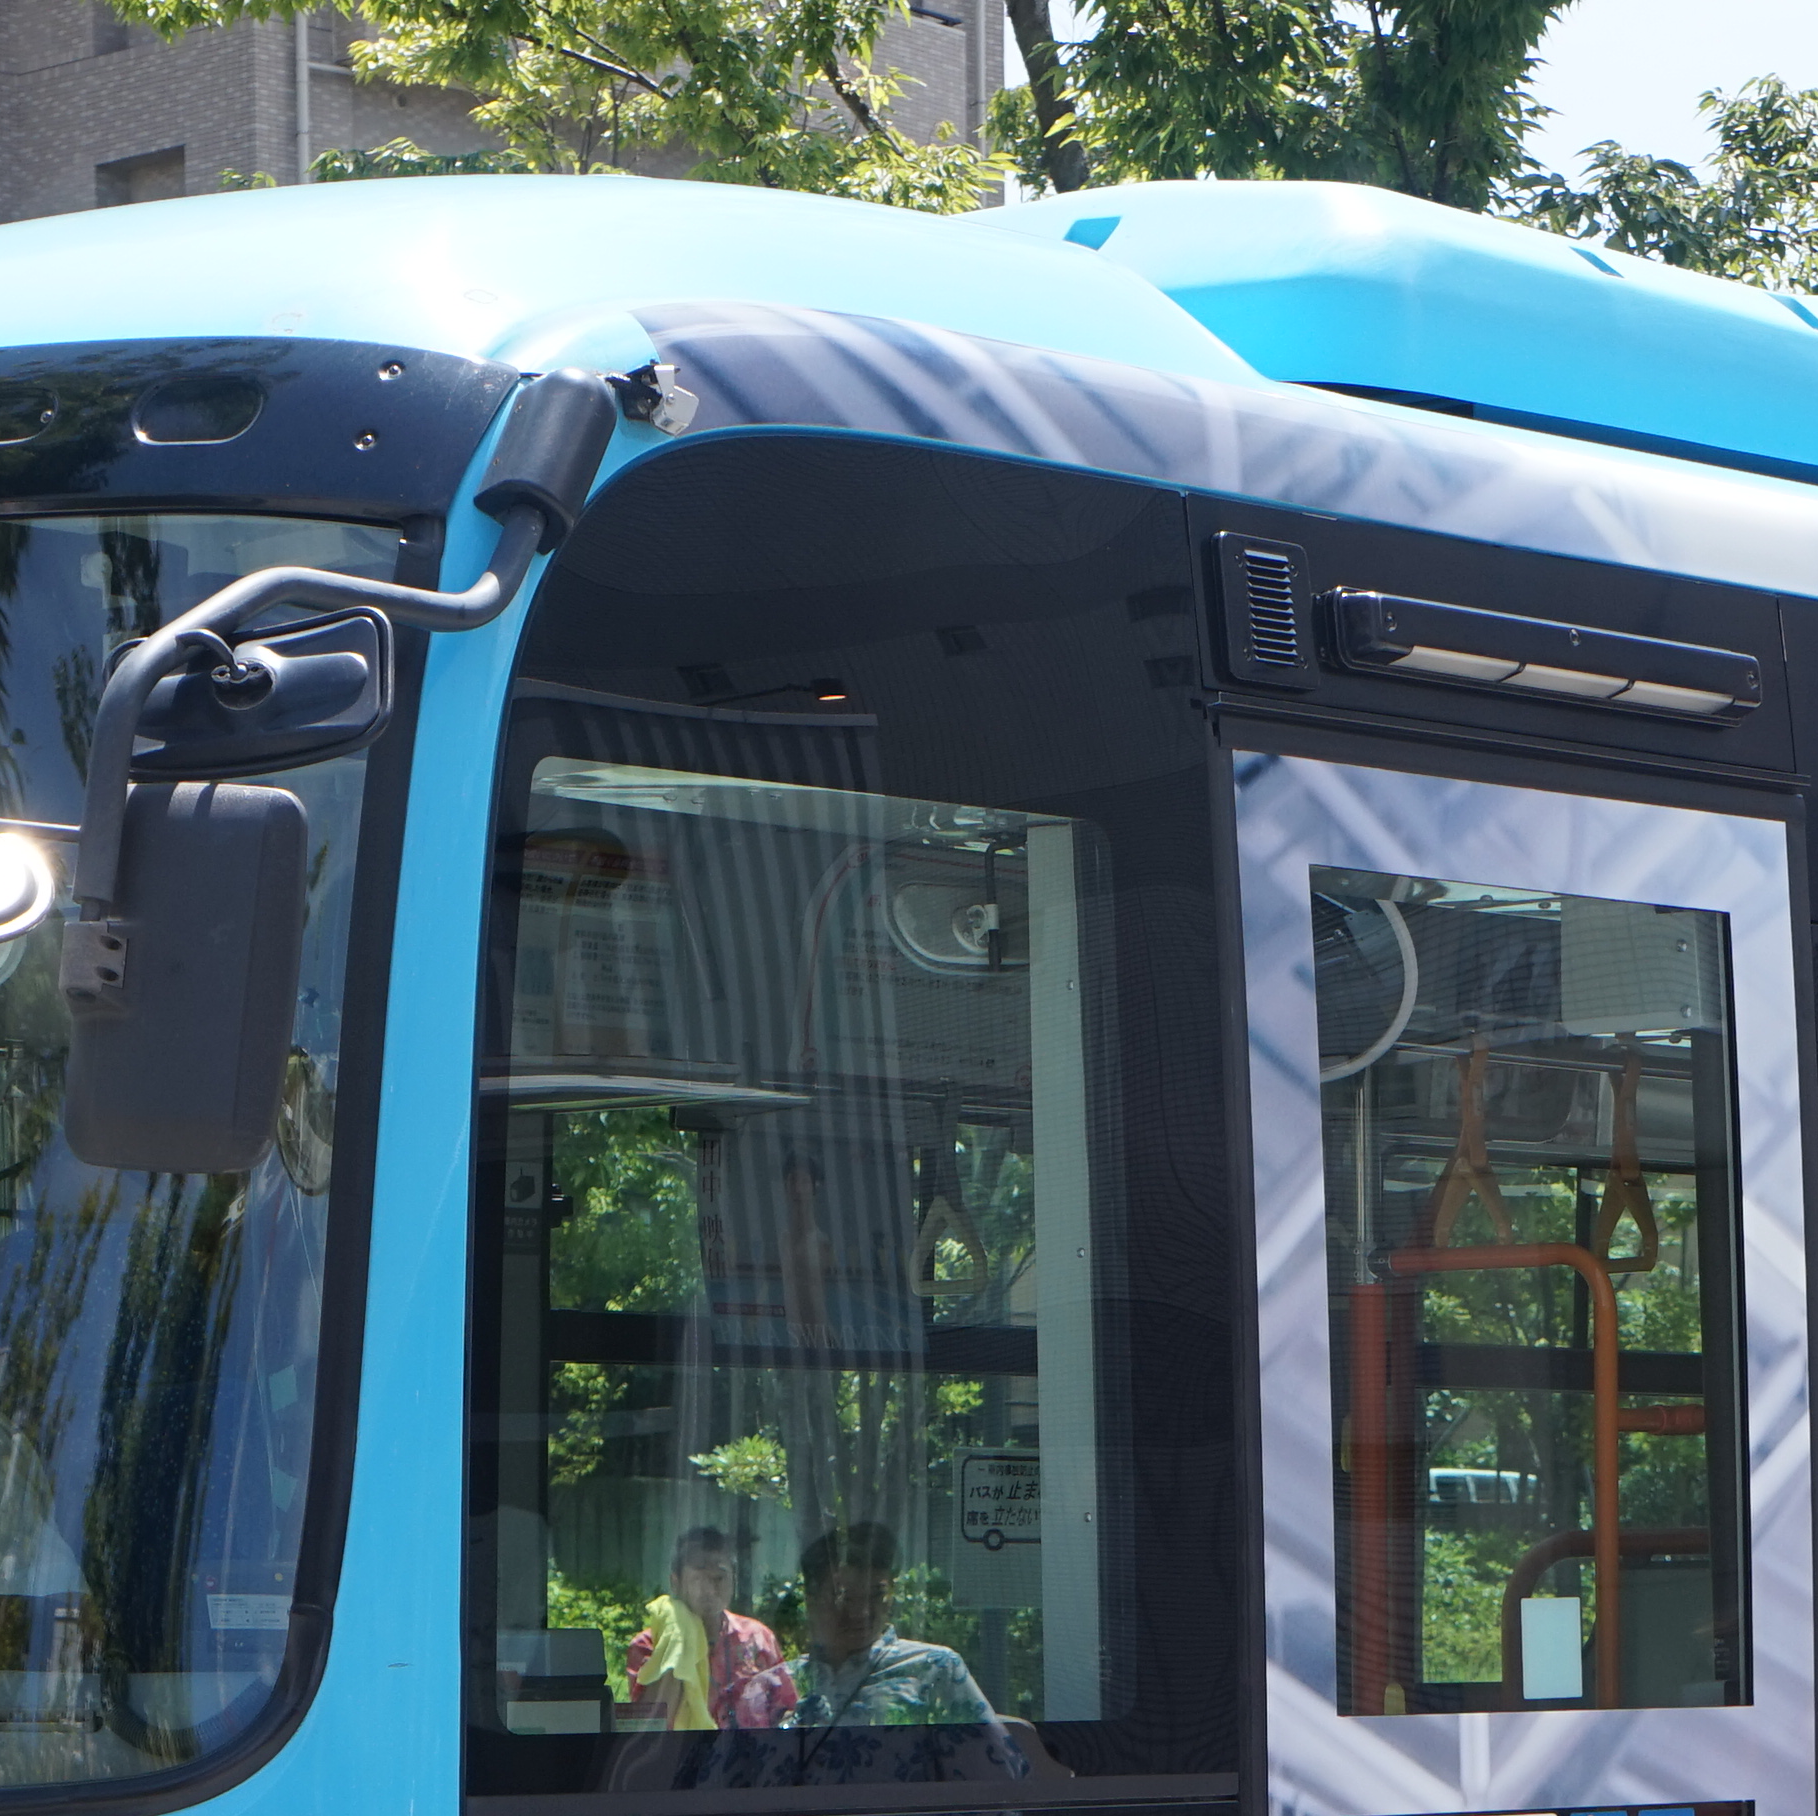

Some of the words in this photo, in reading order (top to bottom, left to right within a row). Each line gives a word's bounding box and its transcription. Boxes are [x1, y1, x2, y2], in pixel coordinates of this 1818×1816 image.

[969, 1480, 1040, 1501] バスが止ま
